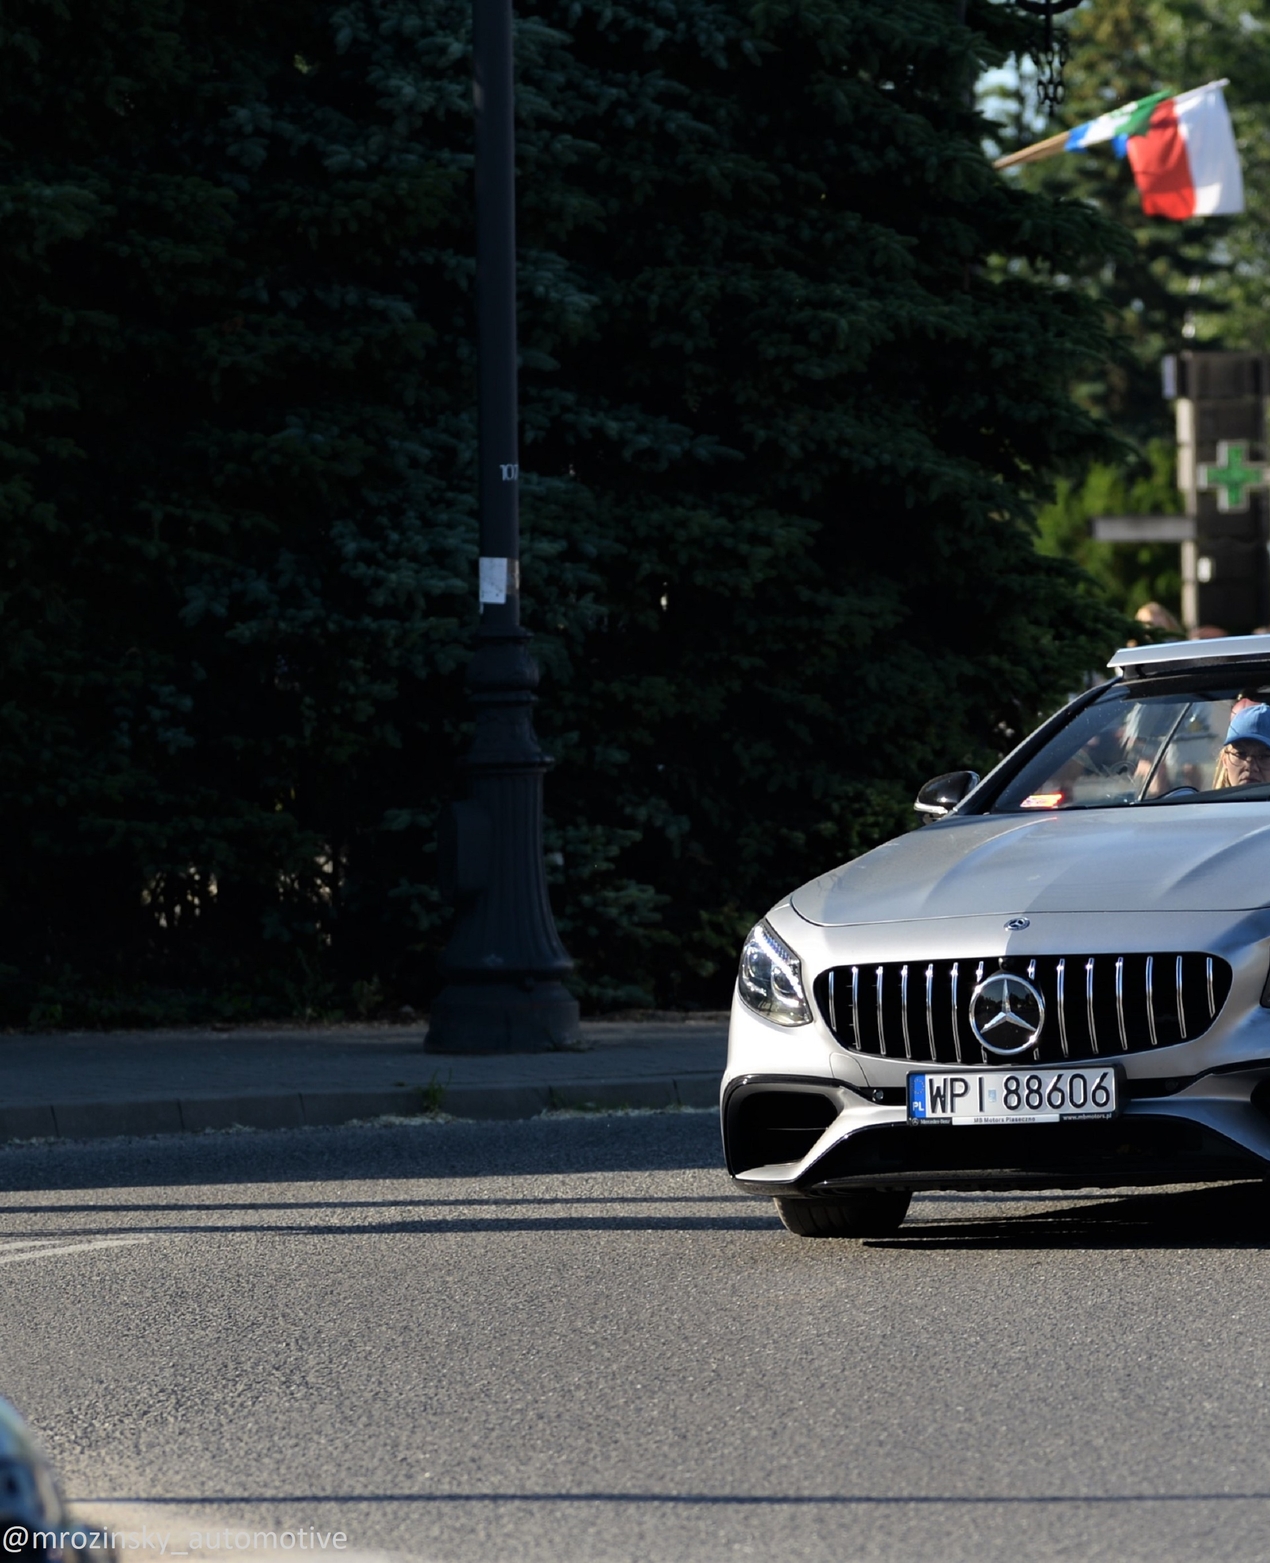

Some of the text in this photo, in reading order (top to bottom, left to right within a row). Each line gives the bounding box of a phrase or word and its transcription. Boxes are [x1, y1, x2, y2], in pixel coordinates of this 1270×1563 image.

[929, 1071, 1112, 1114] WPI 88606
[912, 1101, 925, 1112] PL
